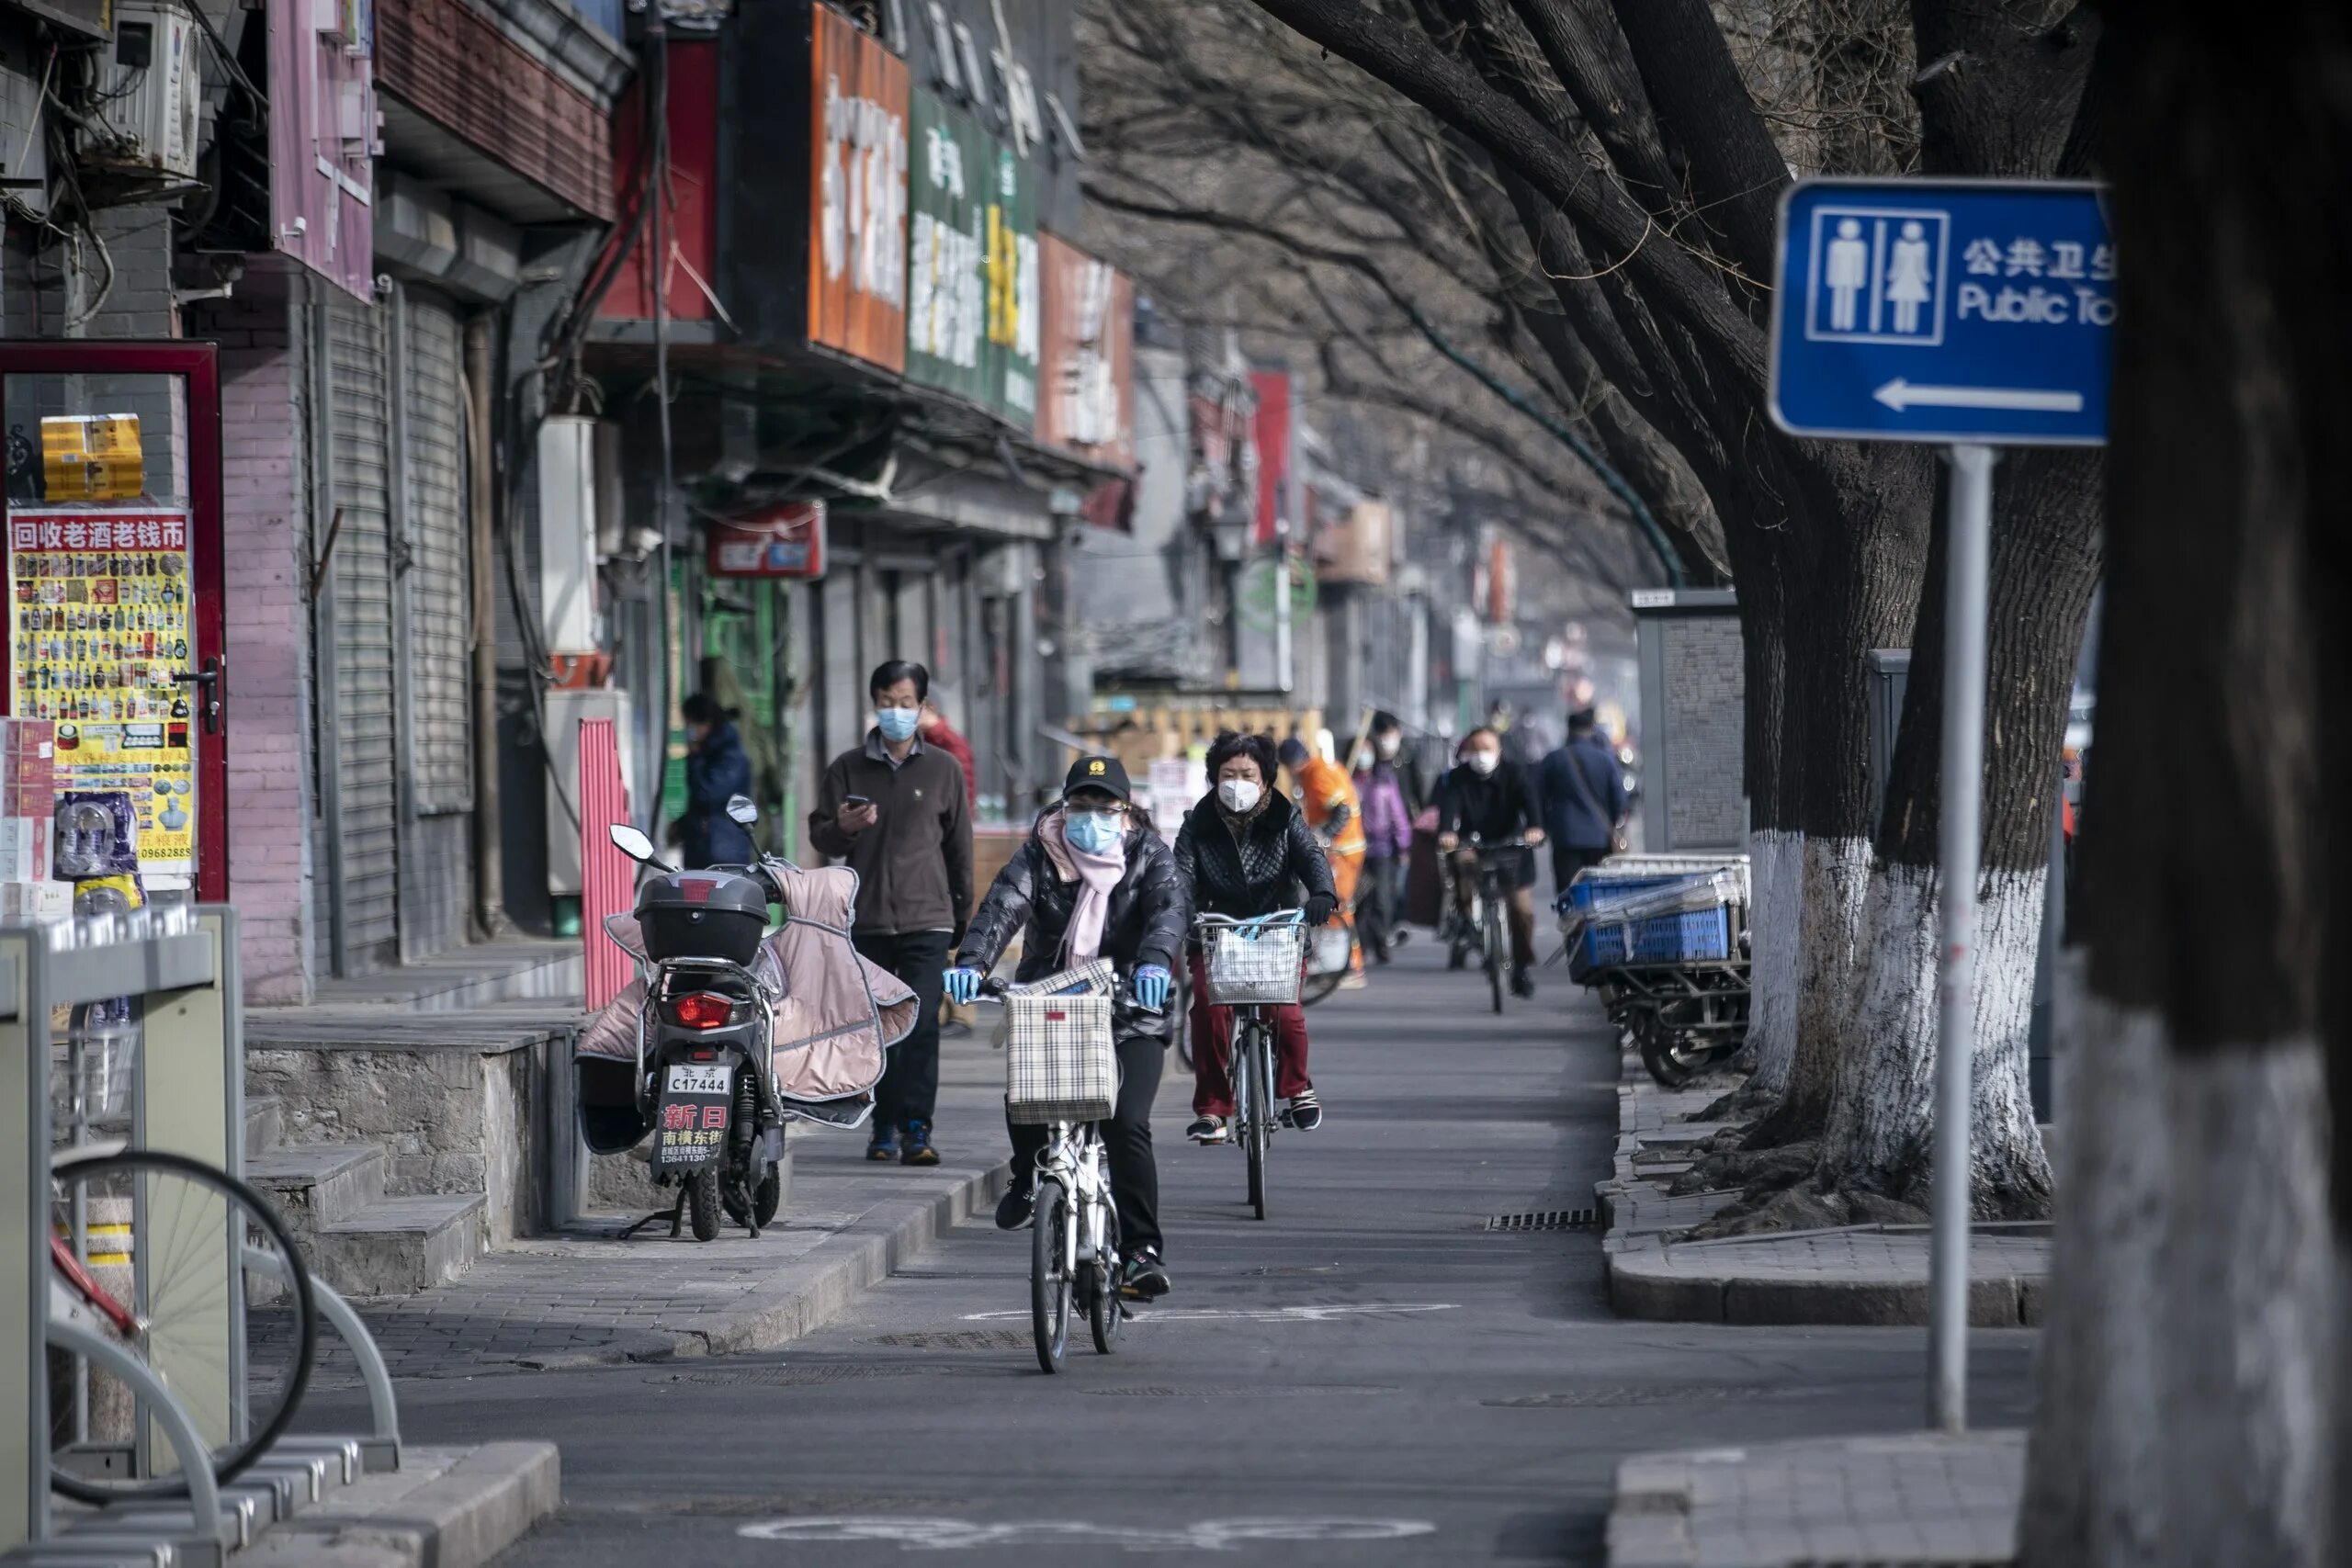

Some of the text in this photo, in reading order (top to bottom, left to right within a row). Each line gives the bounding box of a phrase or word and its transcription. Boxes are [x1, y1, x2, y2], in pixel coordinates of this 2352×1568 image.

[1958, 282, 2068, 323] Public
[14, 521, 185, 548] 回收老酒老钱币
[137, 847, 192, 860] 09682888
[673, 1078, 724, 1091] C17444
[663, 1104, 727, 1129] 新日
[662, 1130, 724, 1145] 南横东街
